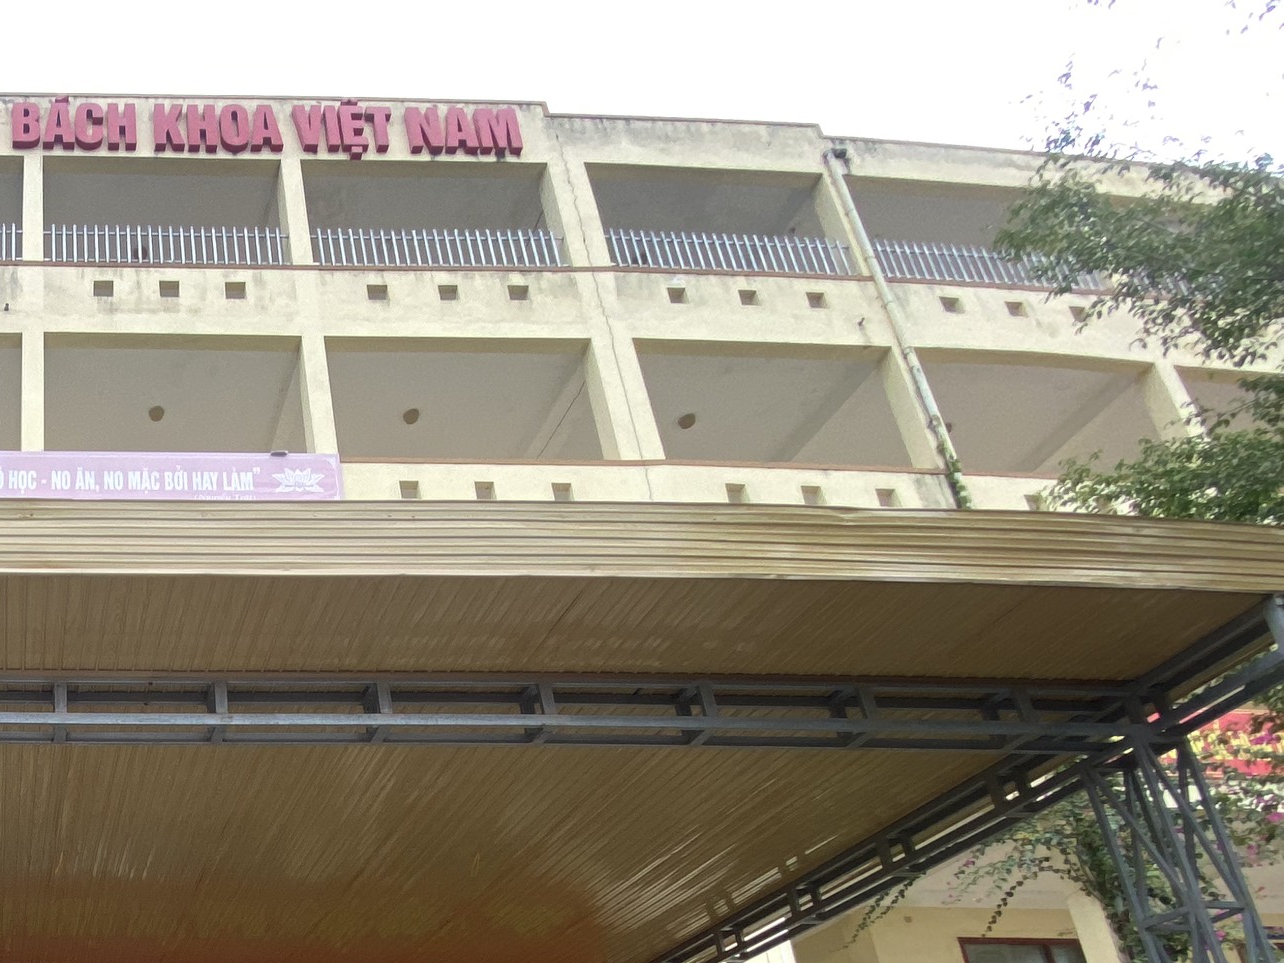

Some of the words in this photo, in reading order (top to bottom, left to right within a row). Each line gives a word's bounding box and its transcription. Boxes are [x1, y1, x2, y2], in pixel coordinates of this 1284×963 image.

[12, 96, 137, 151] BÁCH
[153, 102, 284, 154] KHOA
[292, 99, 392, 160] VIỆT
[404, 105, 524, 156] NAM
[8, 470, 37, 495] HỌC
[51, 470, 71, 490] NO
[75, 466, 100, 493] ĂN,
[103, 470, 124, 491] NO
[127, 467, 160, 494] MẶC
[192, 471, 219, 491] HAY
